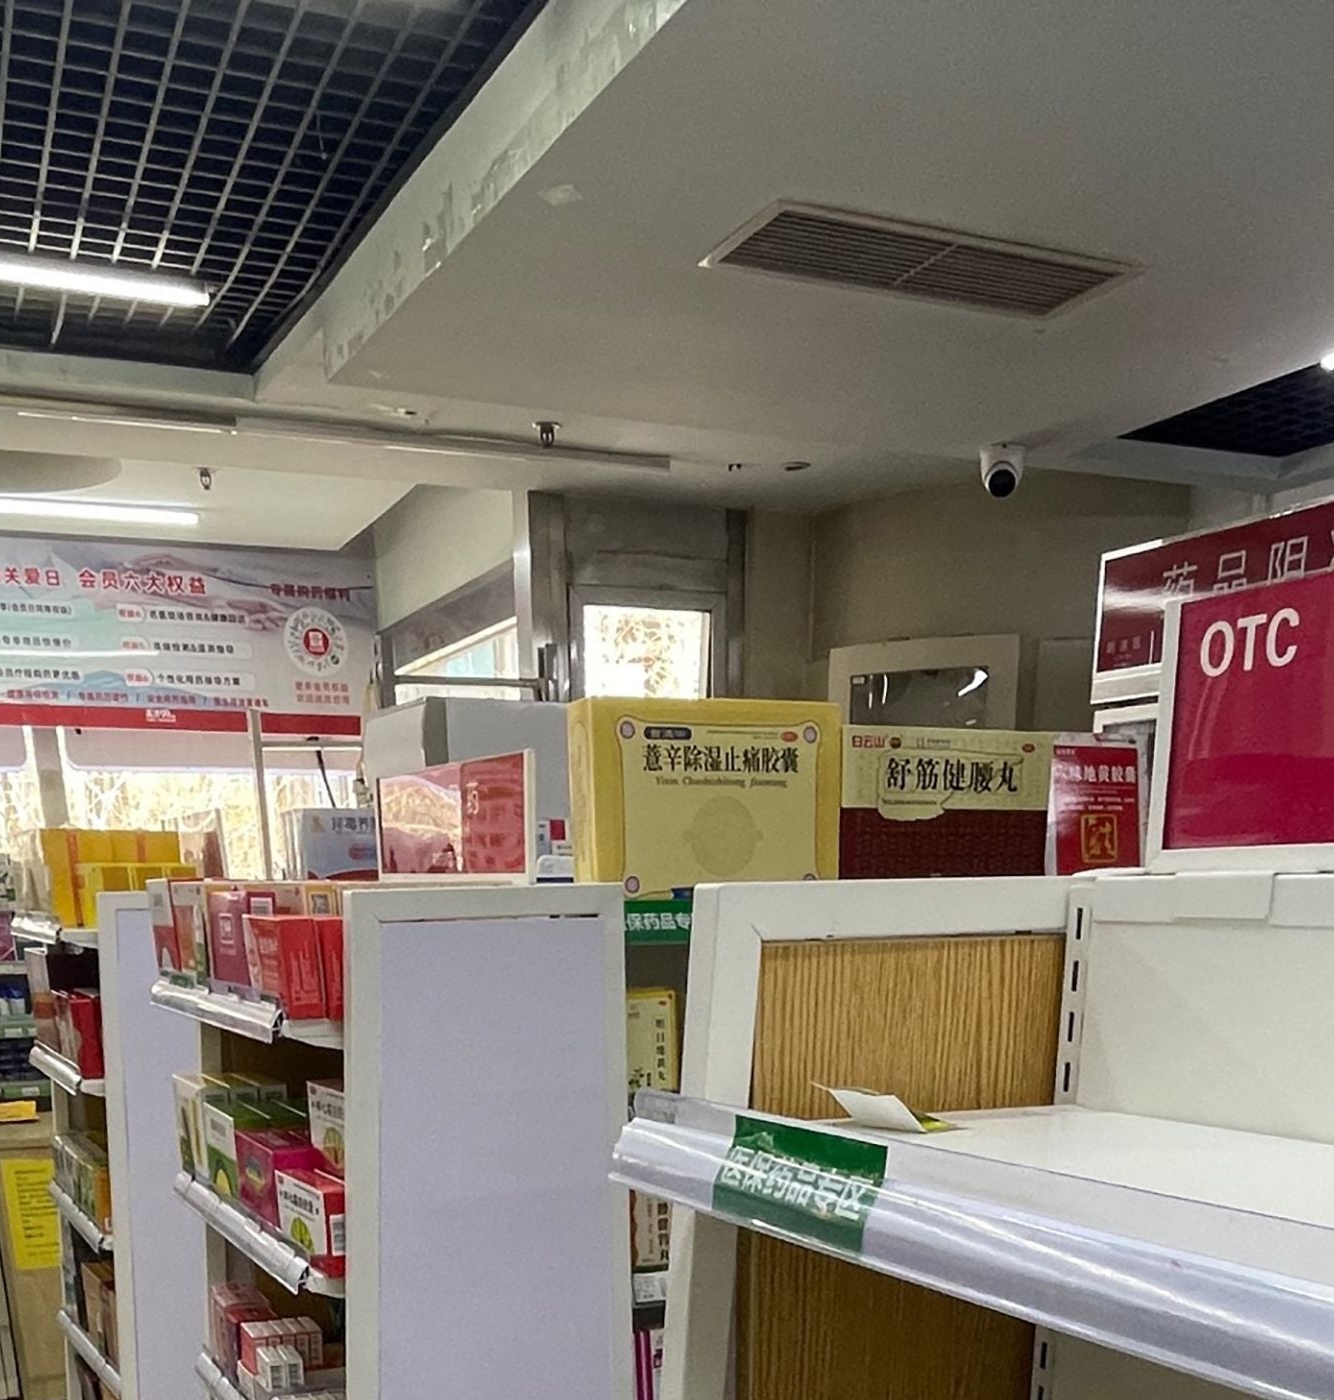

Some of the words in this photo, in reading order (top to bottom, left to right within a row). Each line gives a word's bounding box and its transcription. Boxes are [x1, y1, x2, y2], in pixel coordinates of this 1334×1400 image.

[78, 568, 207, 595] 会员六大权益
[1199, 607, 1300, 678] OTC
[887, 756, 1019, 794] 舒筋健腰丸
[622, 912, 692, 932] 保药品专
[720, 1145, 874, 1221] 医保药品专区
